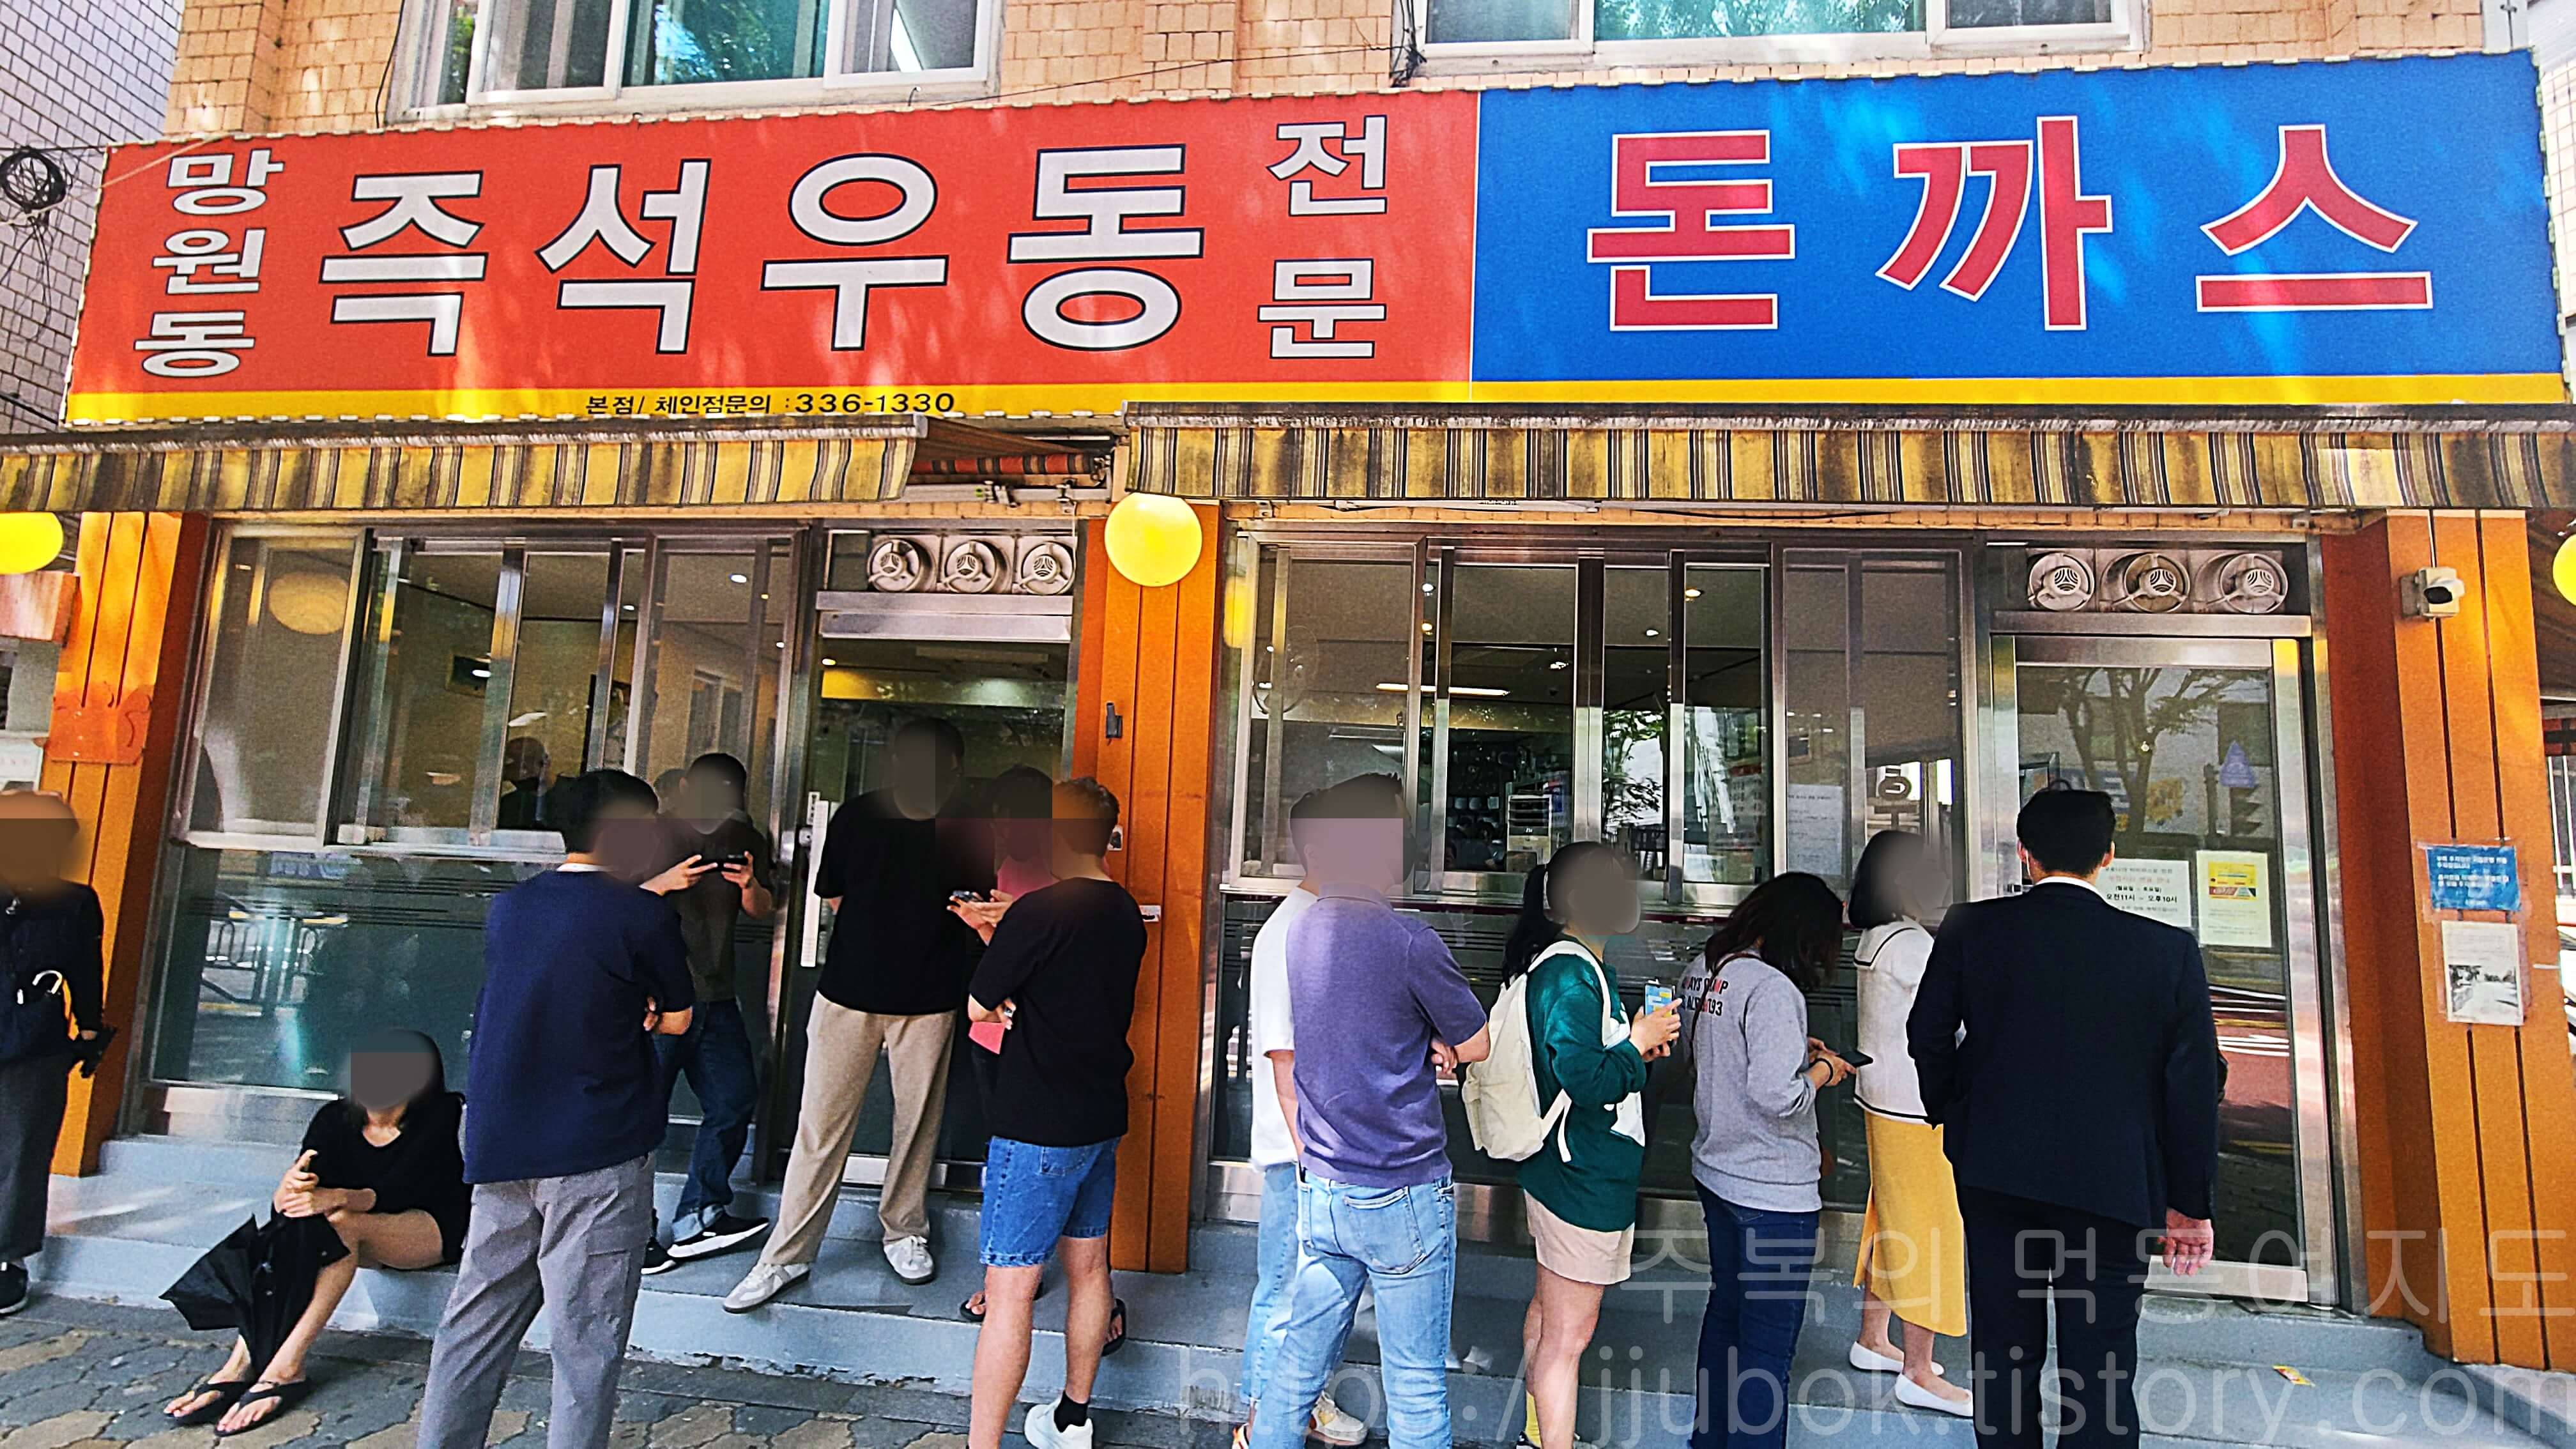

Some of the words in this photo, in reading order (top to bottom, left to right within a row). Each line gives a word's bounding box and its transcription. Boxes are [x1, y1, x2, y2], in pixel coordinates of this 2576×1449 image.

[134, 148, 285, 378] 망원동
[319, 144, 1205, 356] 즉석우동
[1257, 114, 1388, 358] 전문
[1586, 115, 2434, 331] 돈까스
[654, 394, 770, 414] 체인점문의
